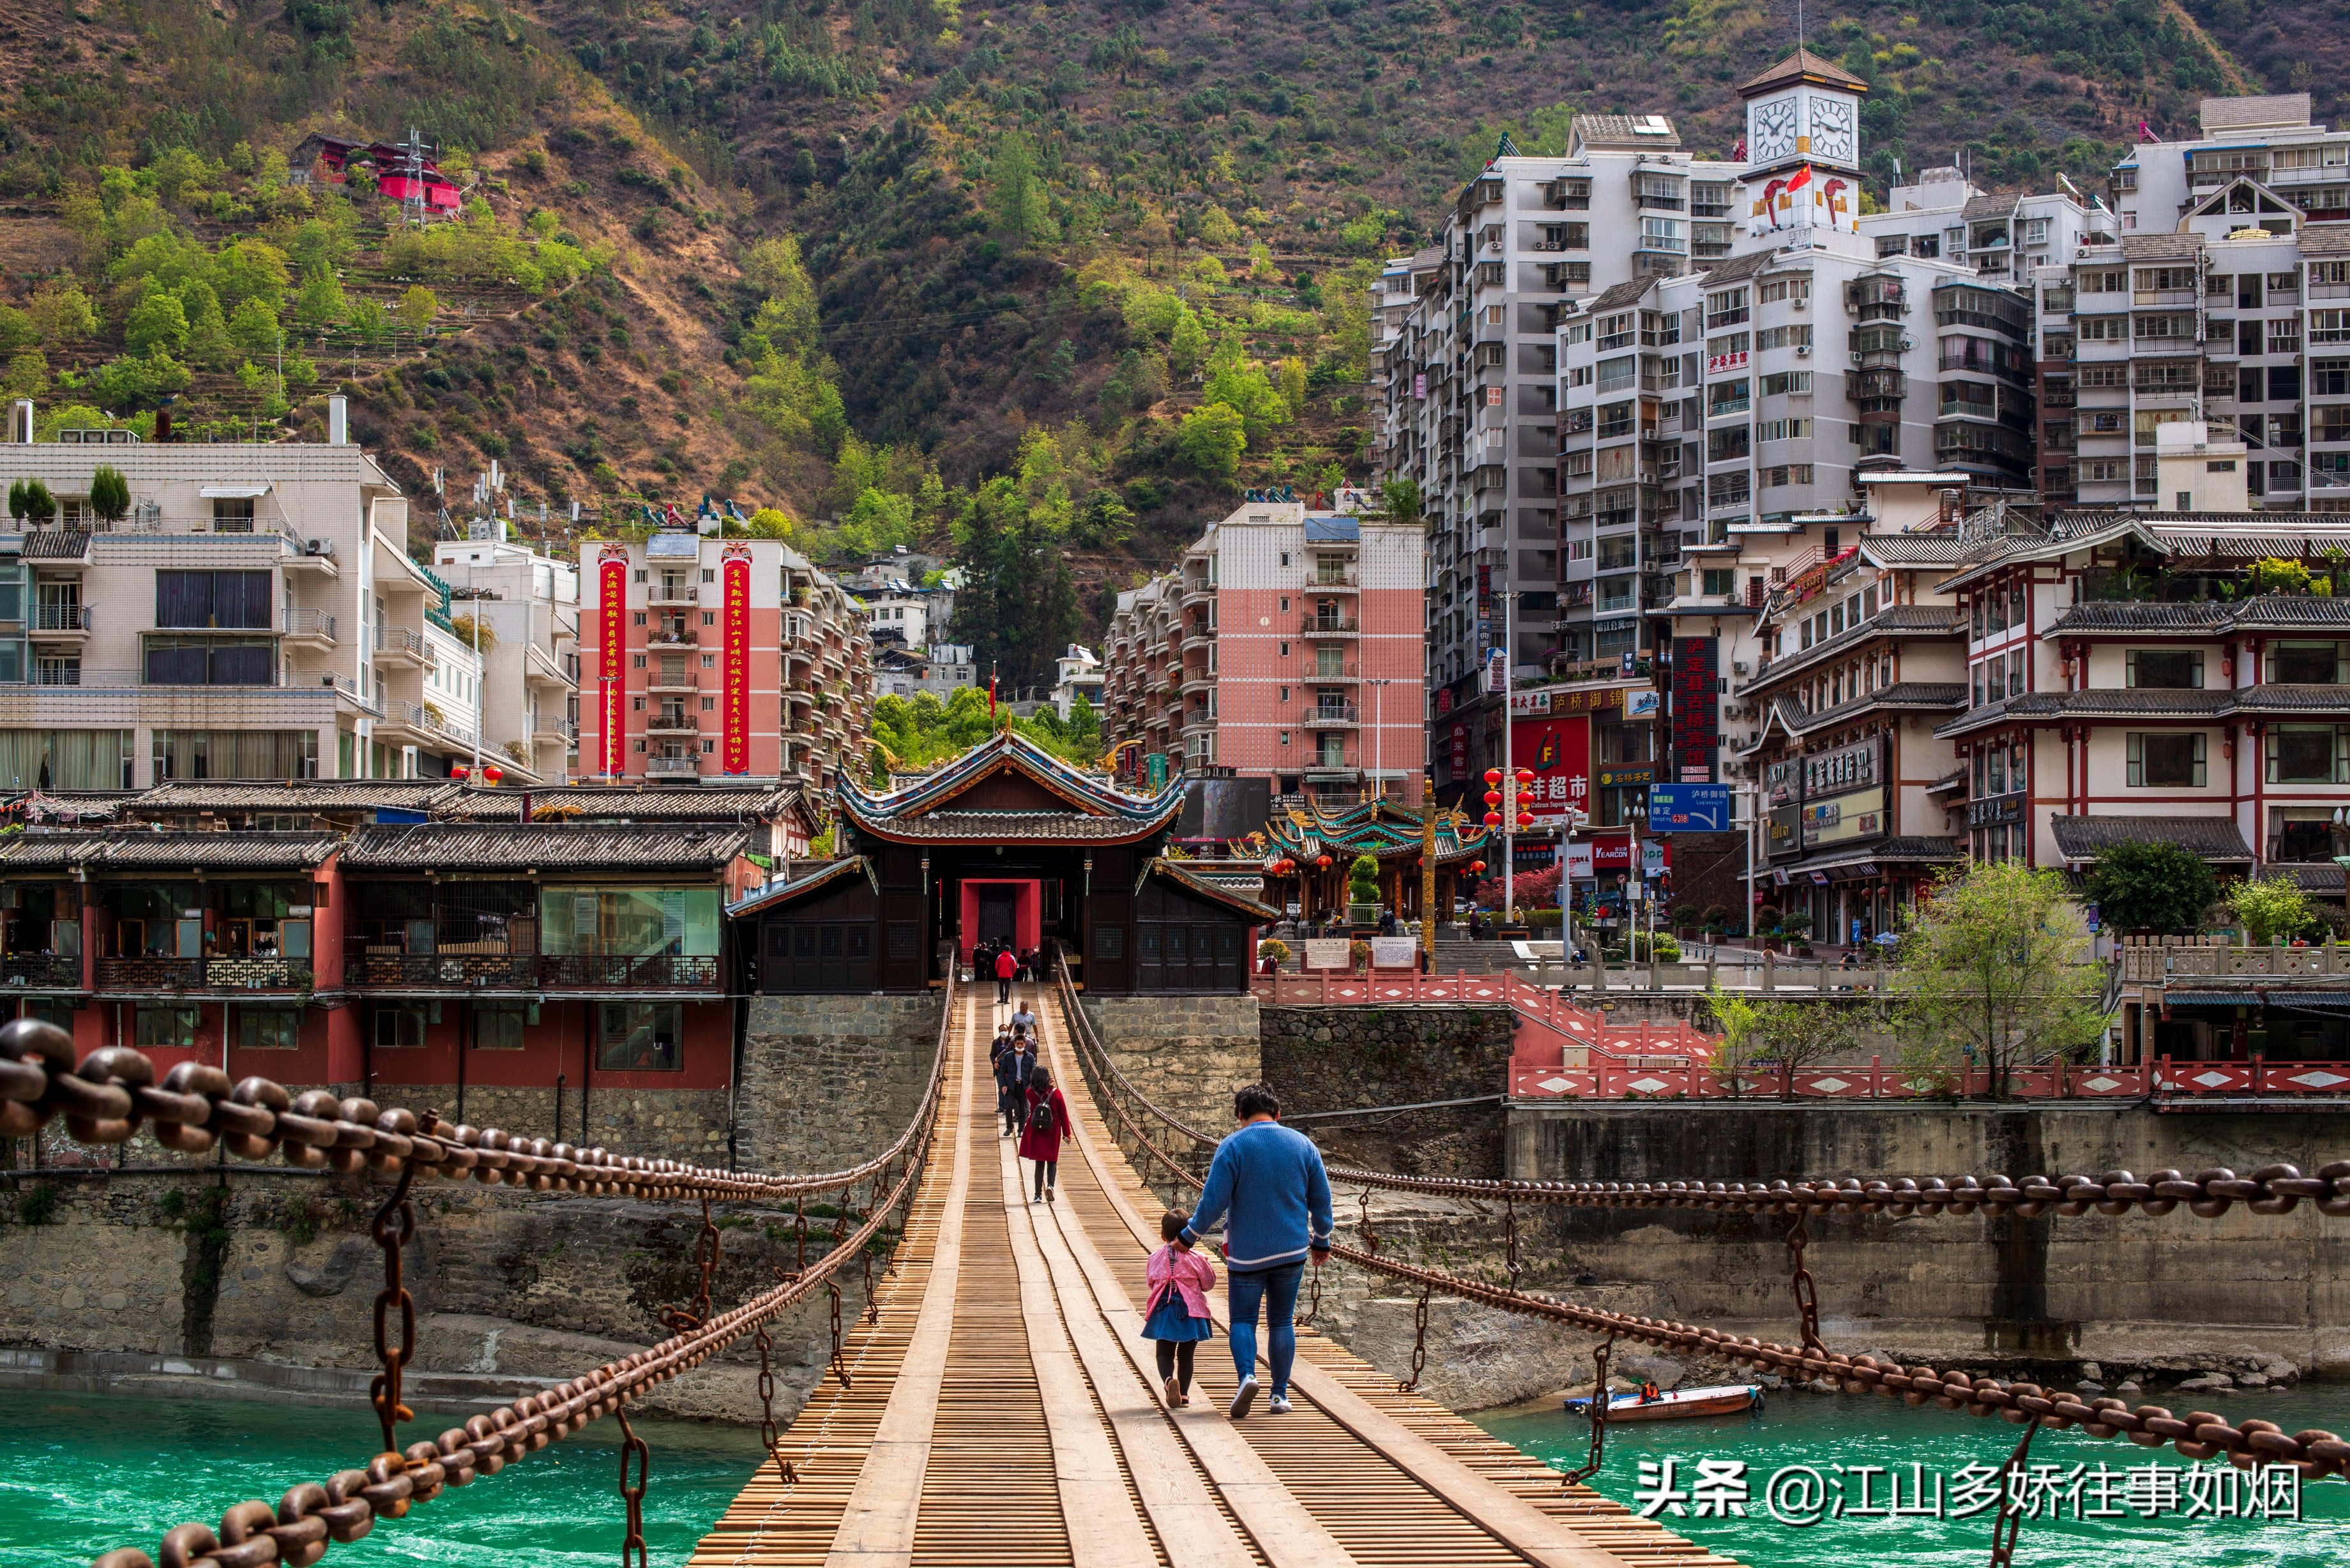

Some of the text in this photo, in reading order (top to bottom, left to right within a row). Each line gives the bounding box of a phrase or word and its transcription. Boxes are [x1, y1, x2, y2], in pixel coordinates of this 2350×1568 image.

[1554, 690, 1623, 711] 泸桥御锦
[1686, 638, 1705, 765] 泸定县古桥宾馆
[1454, 727, 1464, 766] 必来客
[1616, 772, 1651, 783] 名桥茶艺
[1772, 765, 1786, 781] KTV
[1692, 790, 1726, 798] 泸桥御锦
[1653, 806, 1671, 815] 康定
[1596, 847, 1627, 858] YEARCON
